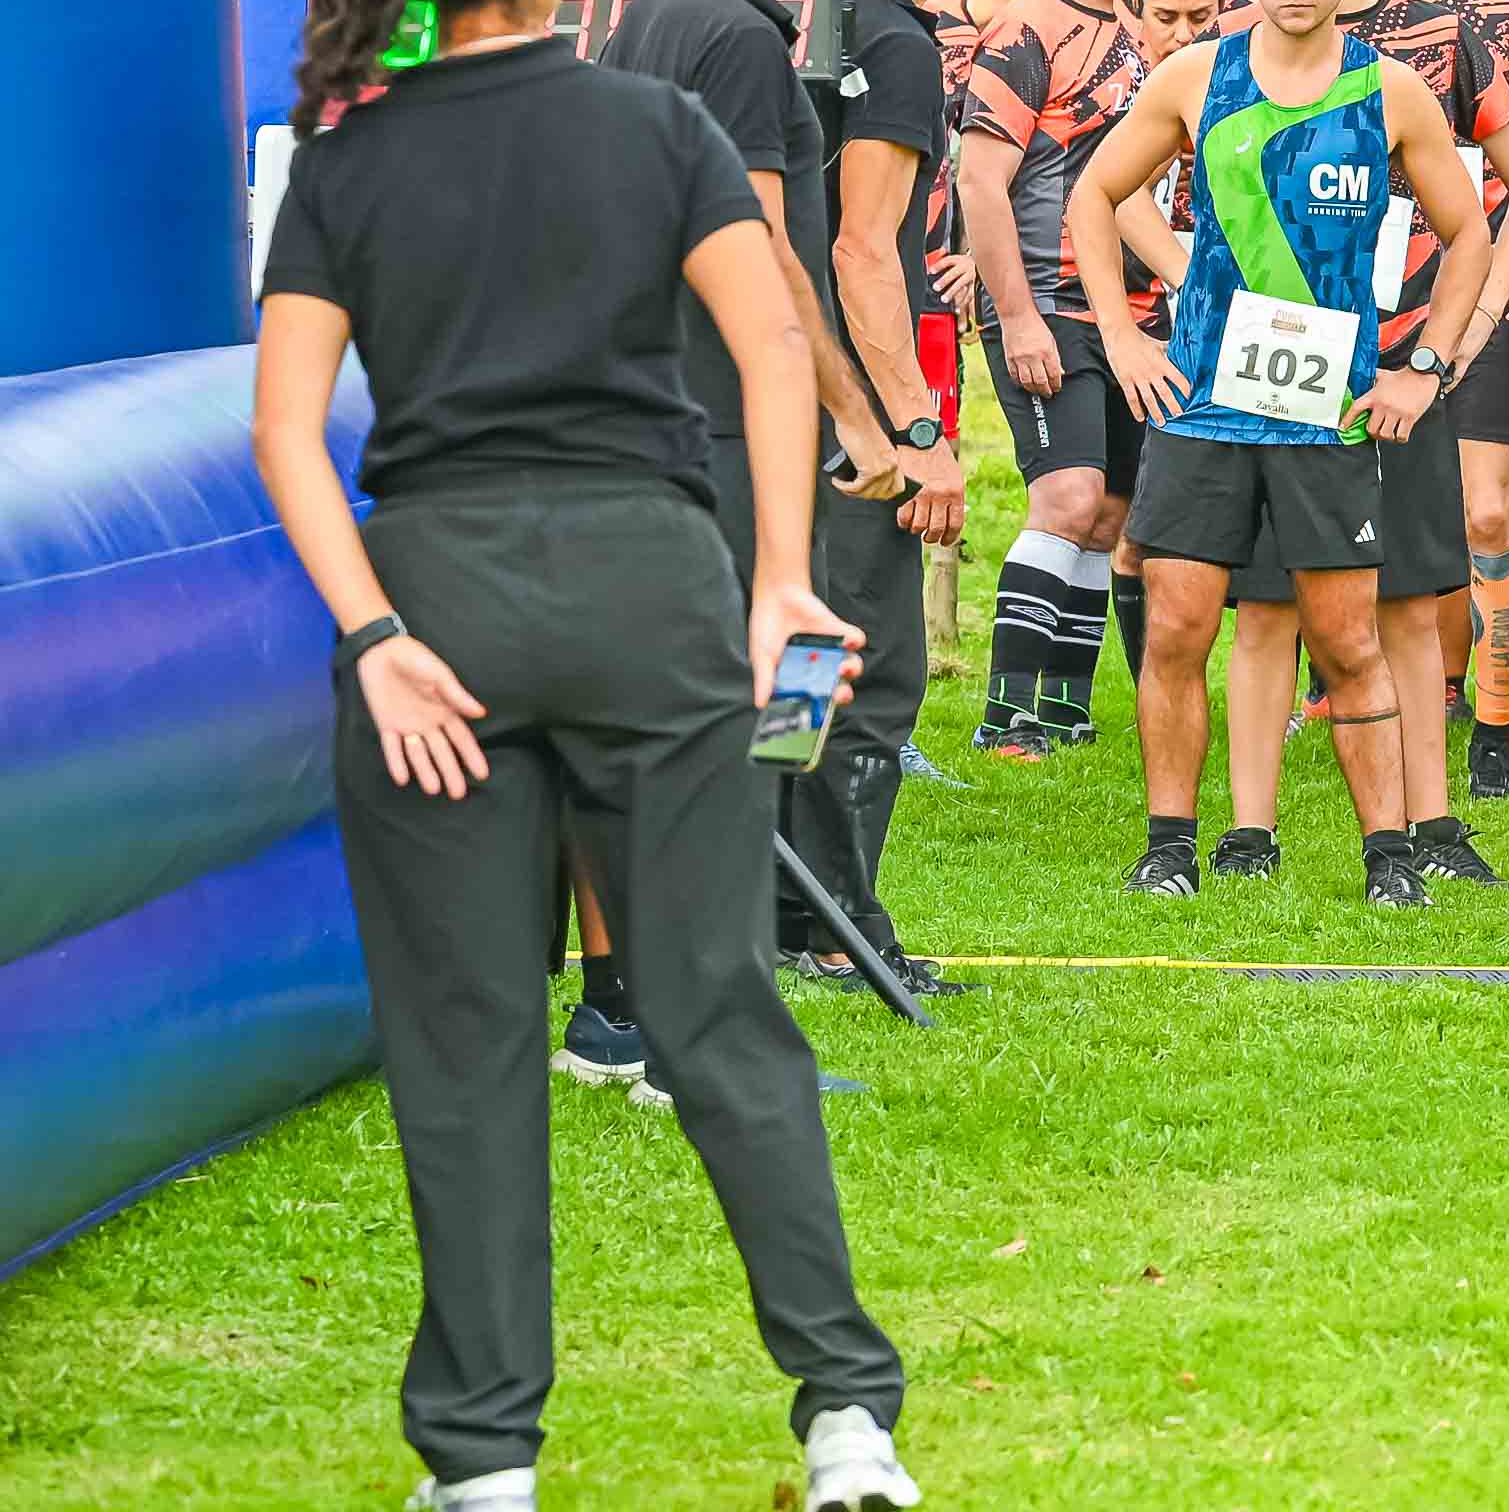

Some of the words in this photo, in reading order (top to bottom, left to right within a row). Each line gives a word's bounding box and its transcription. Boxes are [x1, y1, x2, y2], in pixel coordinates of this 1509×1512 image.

[1309, 163, 1371, 202] CM
[1236, 343, 1329, 394] 102
[1255, 400, 1290, 415] Zavalla
